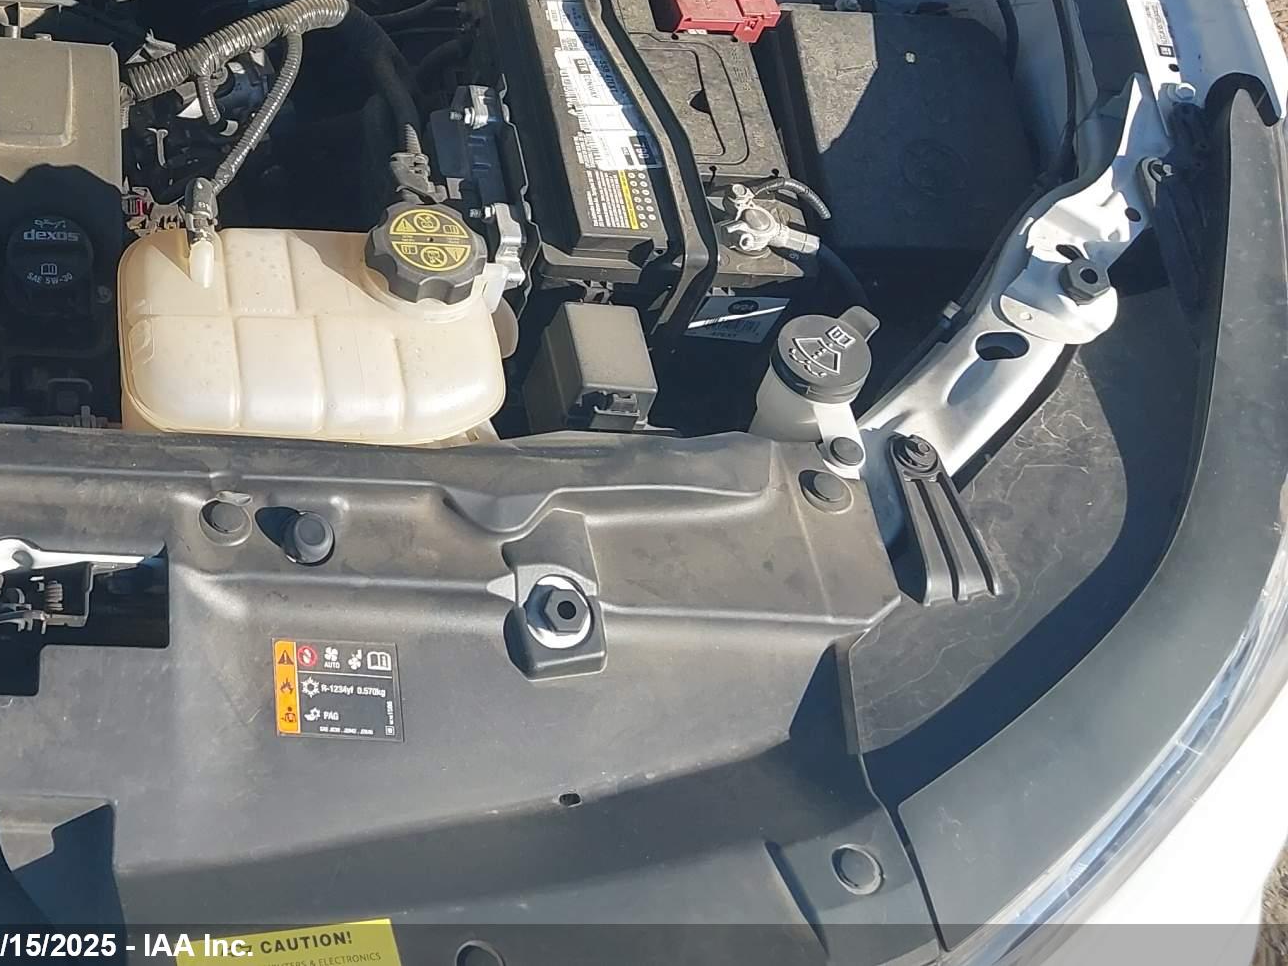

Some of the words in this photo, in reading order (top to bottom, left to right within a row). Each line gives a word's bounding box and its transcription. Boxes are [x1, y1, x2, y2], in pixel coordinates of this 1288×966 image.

[24, 229, 81, 241] dexos
[27, 272, 42, 283] SAE
[45, 273, 73, 284] 5W-30
[323, 661, 341, 669] AUTO
[320, 683, 354, 695] R-1234yf
[356, 686, 386, 698] 0.570kg
[323, 710, 340, 721] PAG
[260, 931, 352, 954] CAUTION!
[318, 952, 382, 966] ELECTRONICS
